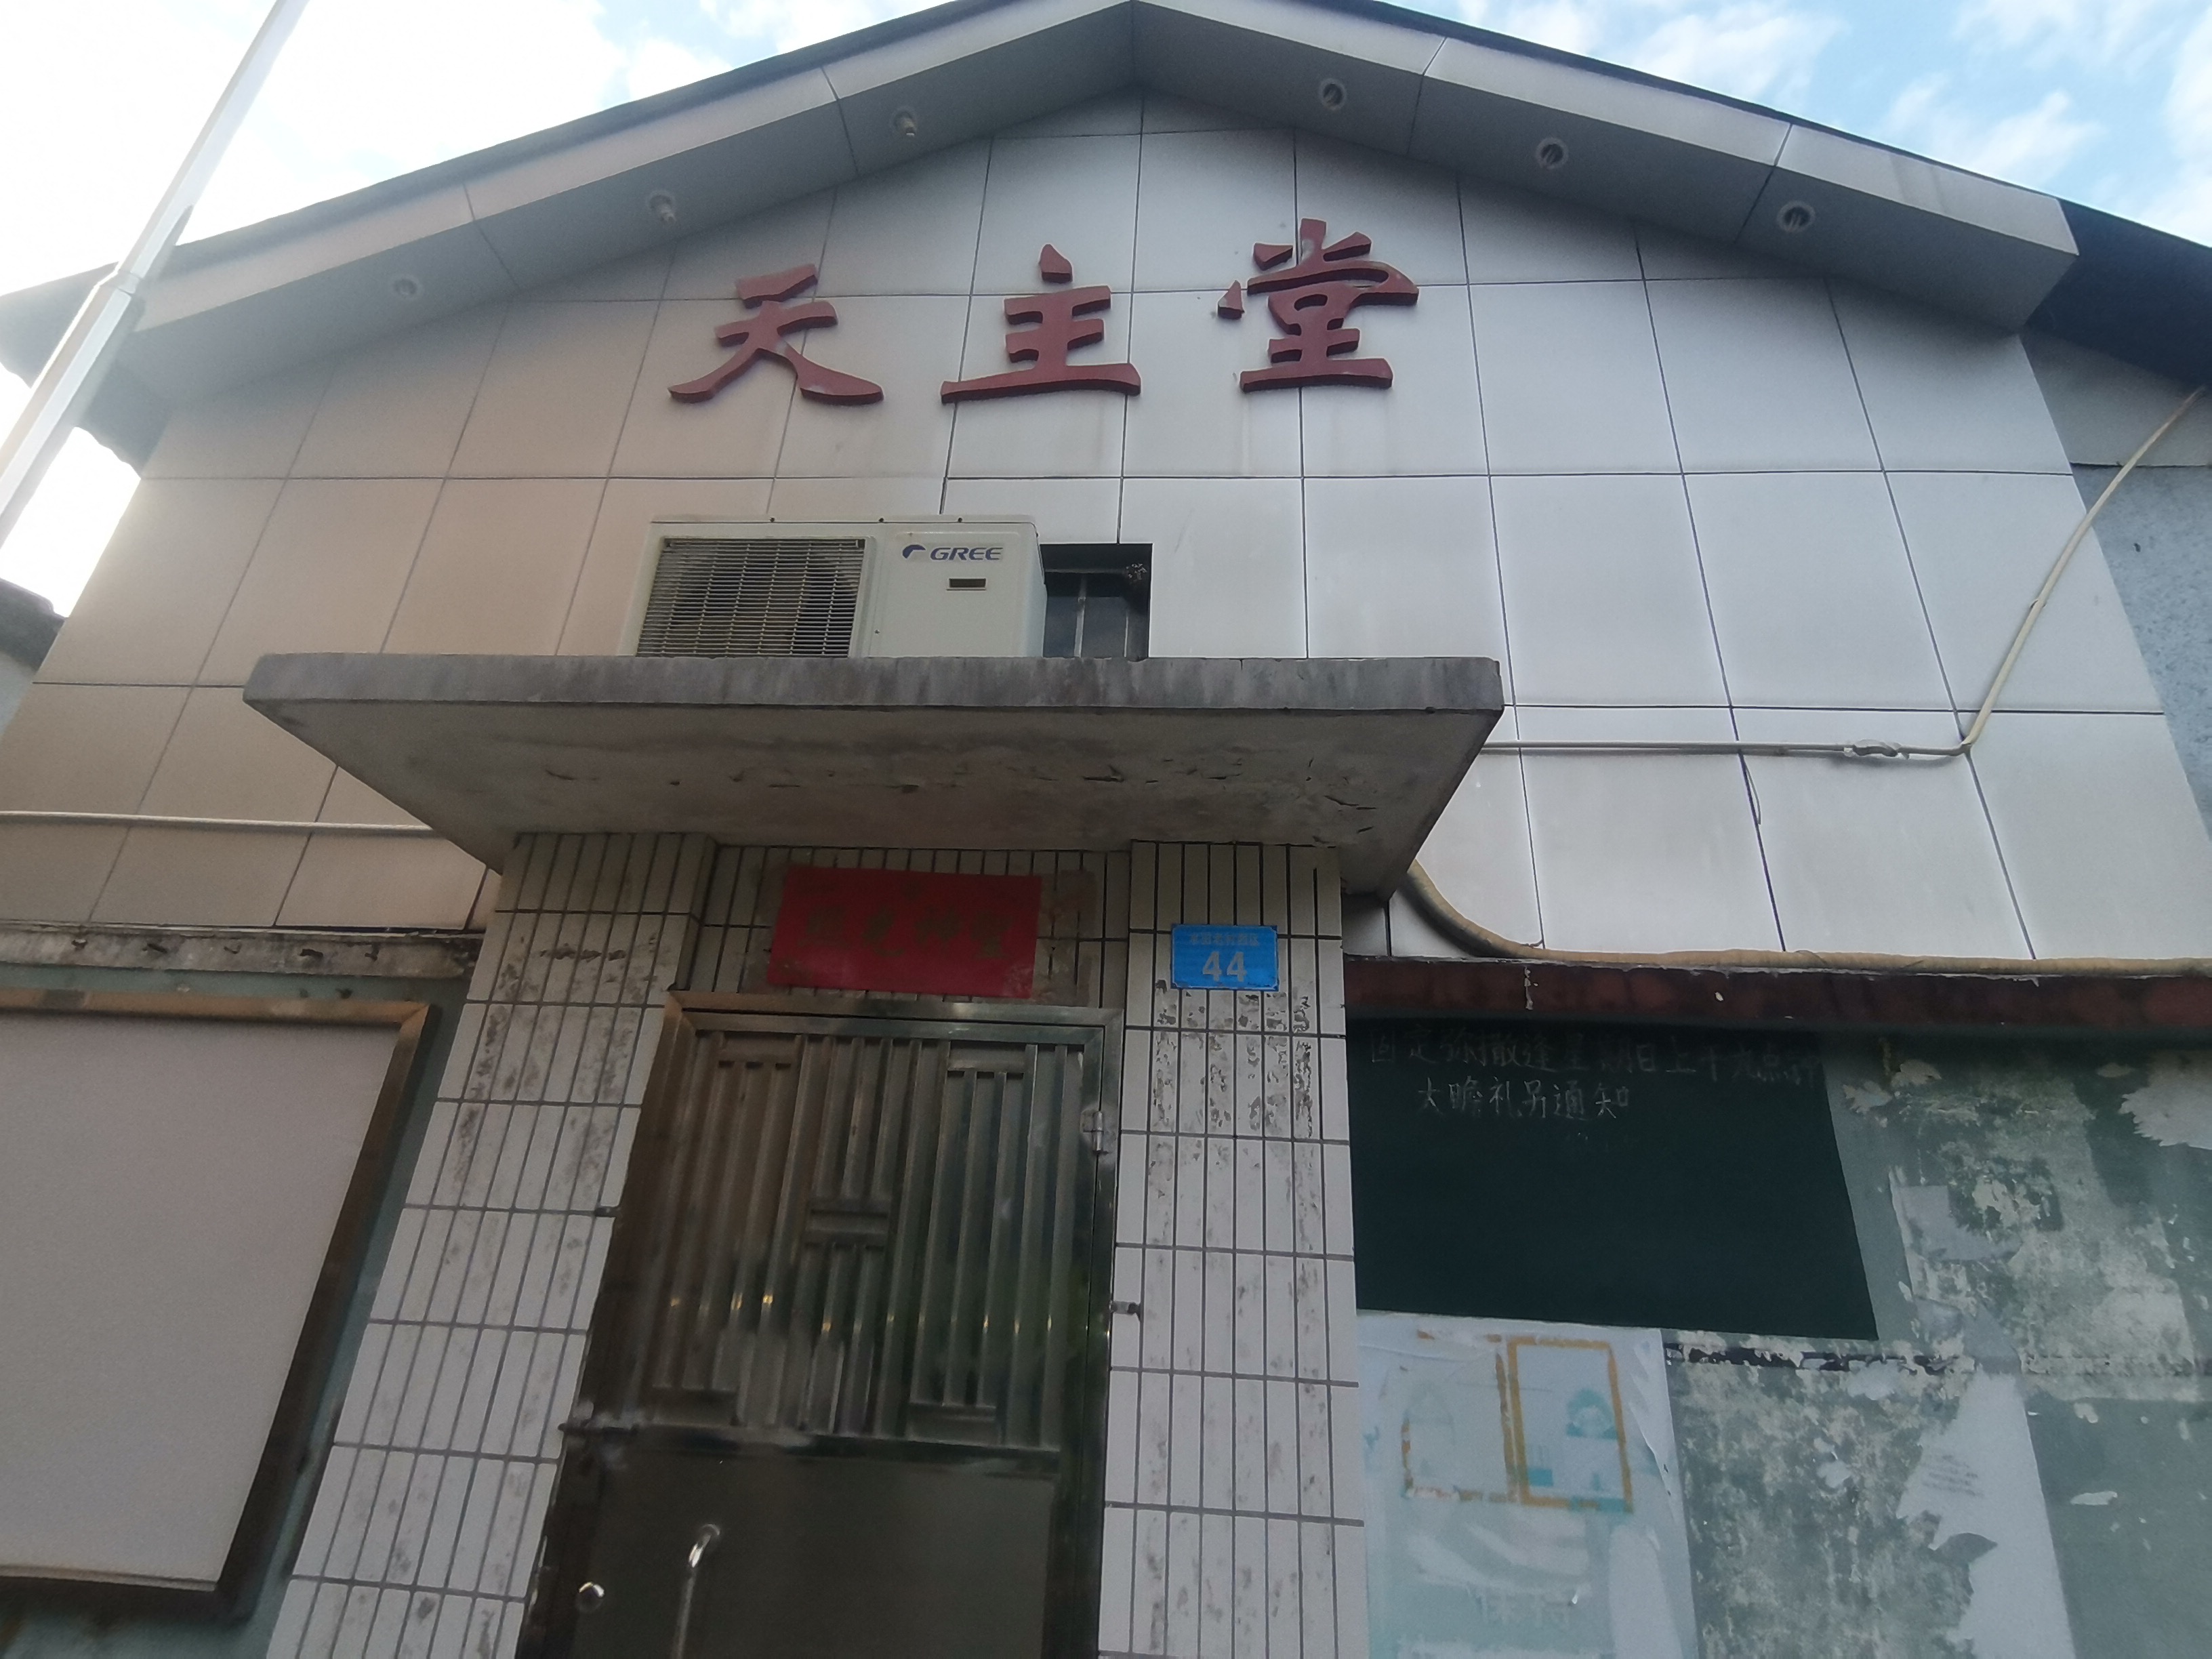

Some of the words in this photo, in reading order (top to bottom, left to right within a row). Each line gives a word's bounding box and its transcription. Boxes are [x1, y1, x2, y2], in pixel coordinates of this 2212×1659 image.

[668, 218, 1418, 404] 天主堂
[930, 547, 1004, 561] GREE
[1202, 950, 1248, 982] 44
